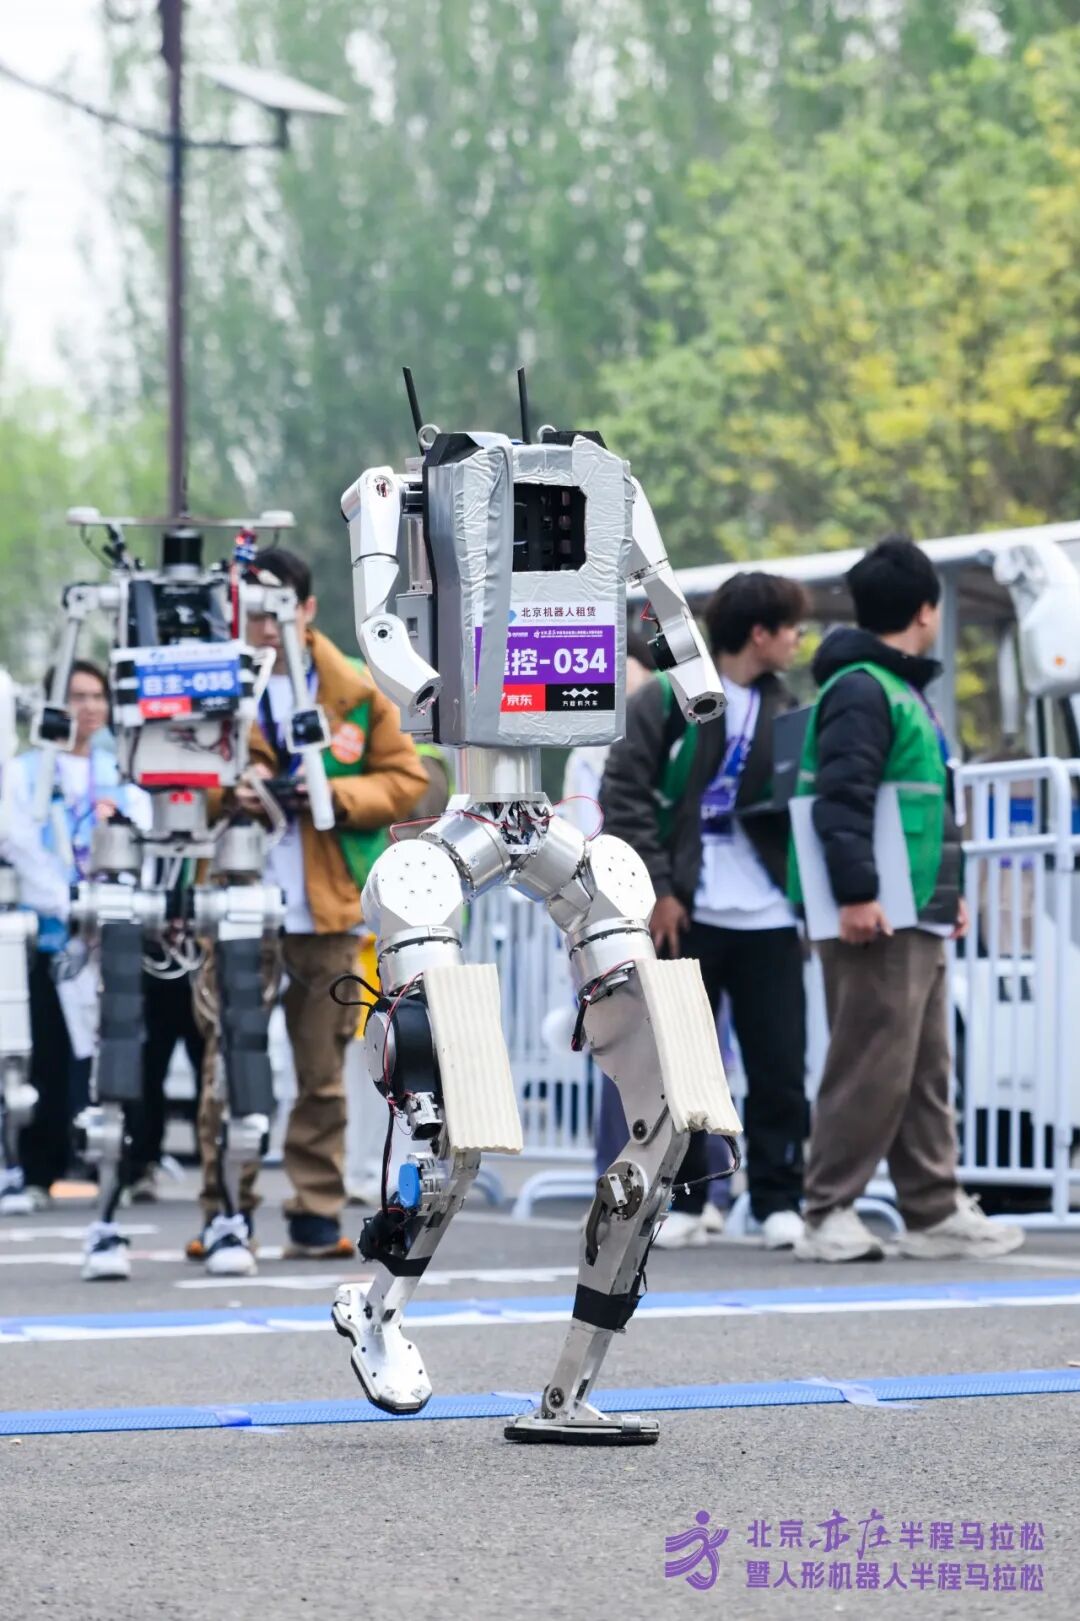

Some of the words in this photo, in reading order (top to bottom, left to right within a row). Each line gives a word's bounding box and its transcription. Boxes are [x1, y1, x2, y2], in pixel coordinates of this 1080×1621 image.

[521, 606, 596, 617] 北京机器人租赁
[504, 648, 607, 676] 控-034
[507, 694, 533, 706] 京东
